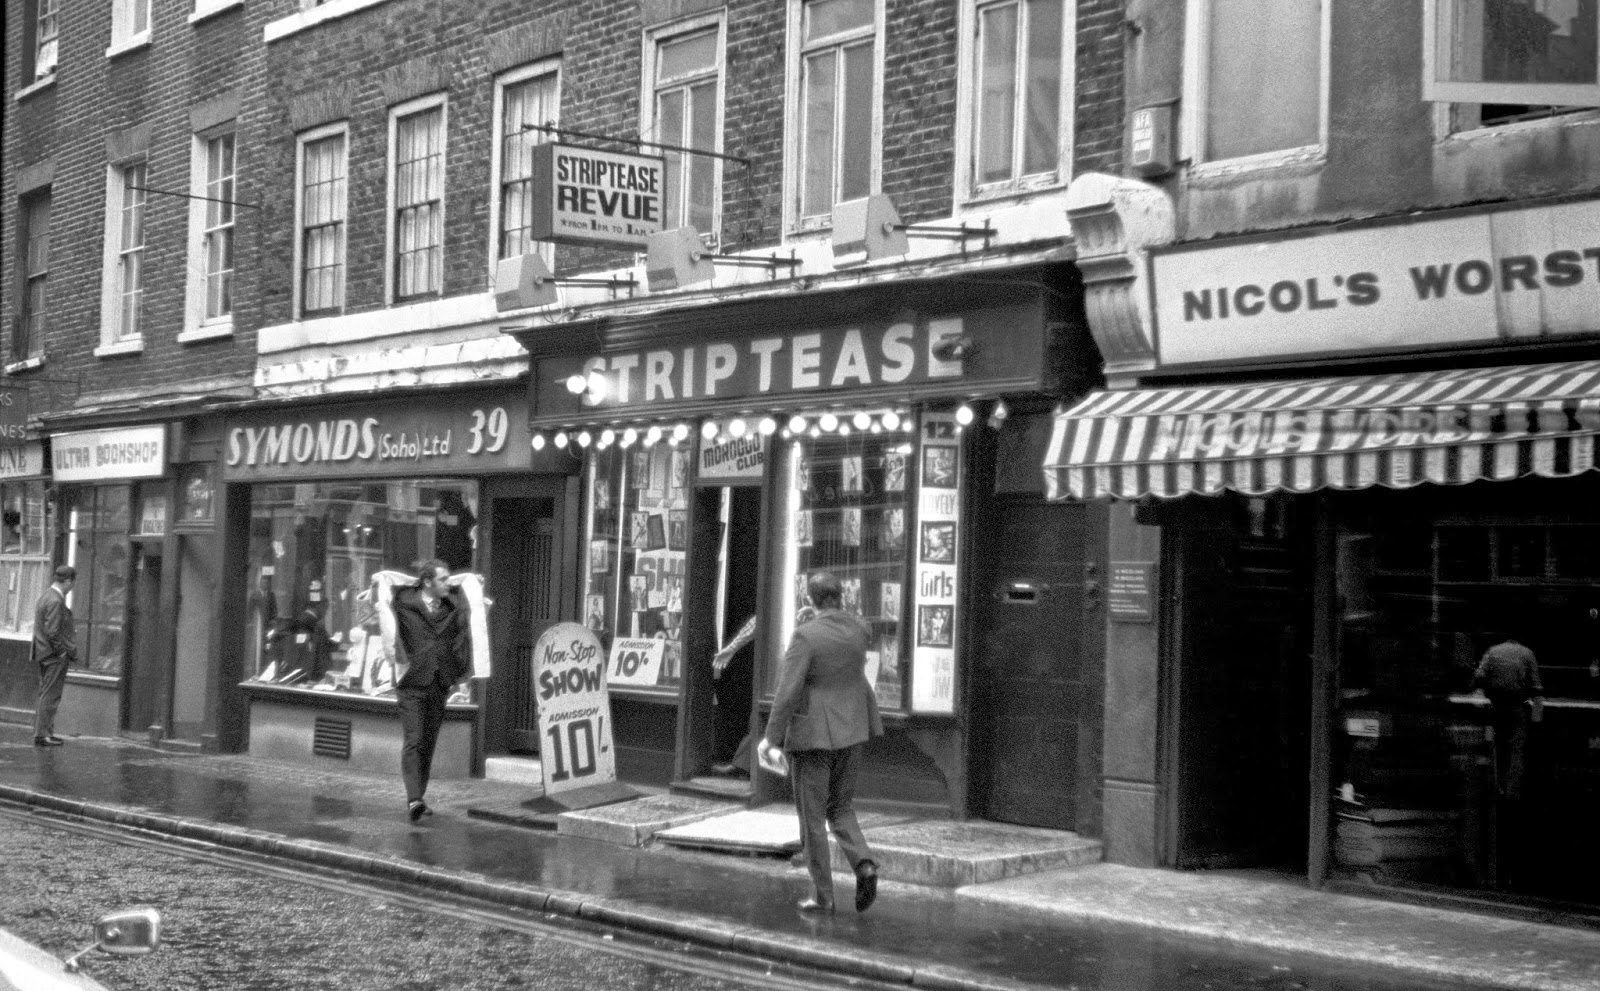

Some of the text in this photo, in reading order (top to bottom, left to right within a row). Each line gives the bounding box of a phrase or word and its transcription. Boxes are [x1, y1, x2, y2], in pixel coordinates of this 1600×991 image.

[557, 155, 658, 194] STRIPTEASE
[557, 185, 658, 223] REVUE
[568, 221, 588, 231] FROM
[612, 225, 623, 234] TO
[1182, 271, 1381, 322] NICOL'S
[226, 407, 509, 467] SYMONDS (Soho) Ltd 39
[924, 421, 956, 439] 12
[55, 441, 158, 471] ULTRA BOOKSHOP
[703, 432, 761, 469] MOROCCO
[736, 451, 764, 471] CLUB
[920, 570, 953, 599] Girls
[543, 639, 596, 666] Non-Stop
[619, 641, 655, 650] ADMISSION
[539, 663, 603, 701] SHOW
[548, 707, 599, 723] ADMISSION
